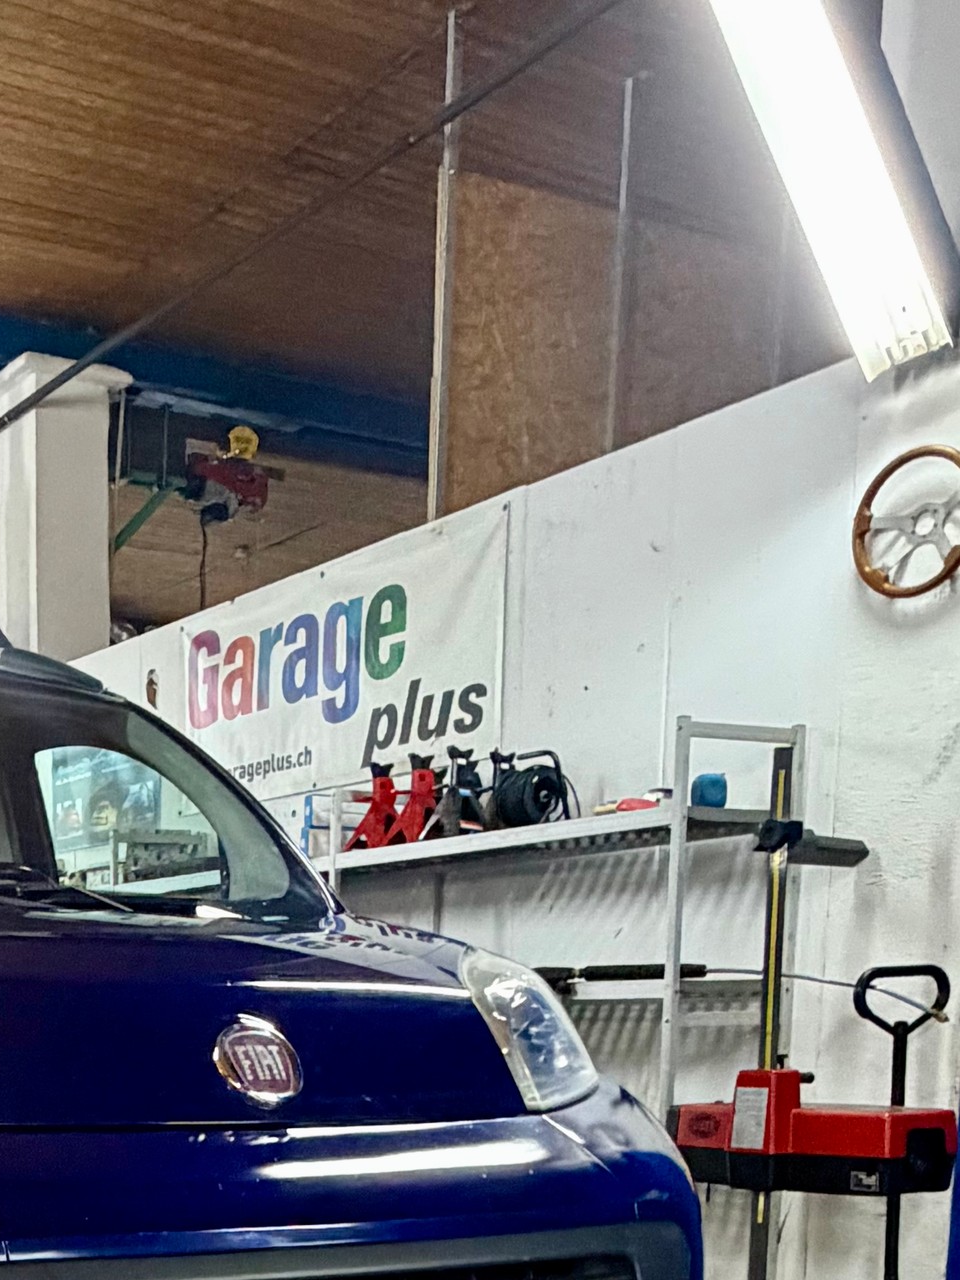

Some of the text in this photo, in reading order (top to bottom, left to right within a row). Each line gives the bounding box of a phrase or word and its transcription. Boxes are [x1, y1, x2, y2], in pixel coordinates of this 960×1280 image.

[189, 584, 407, 730] Garage
[361, 678, 487, 769] plus
[234, 1044, 287, 1081] FIAT
